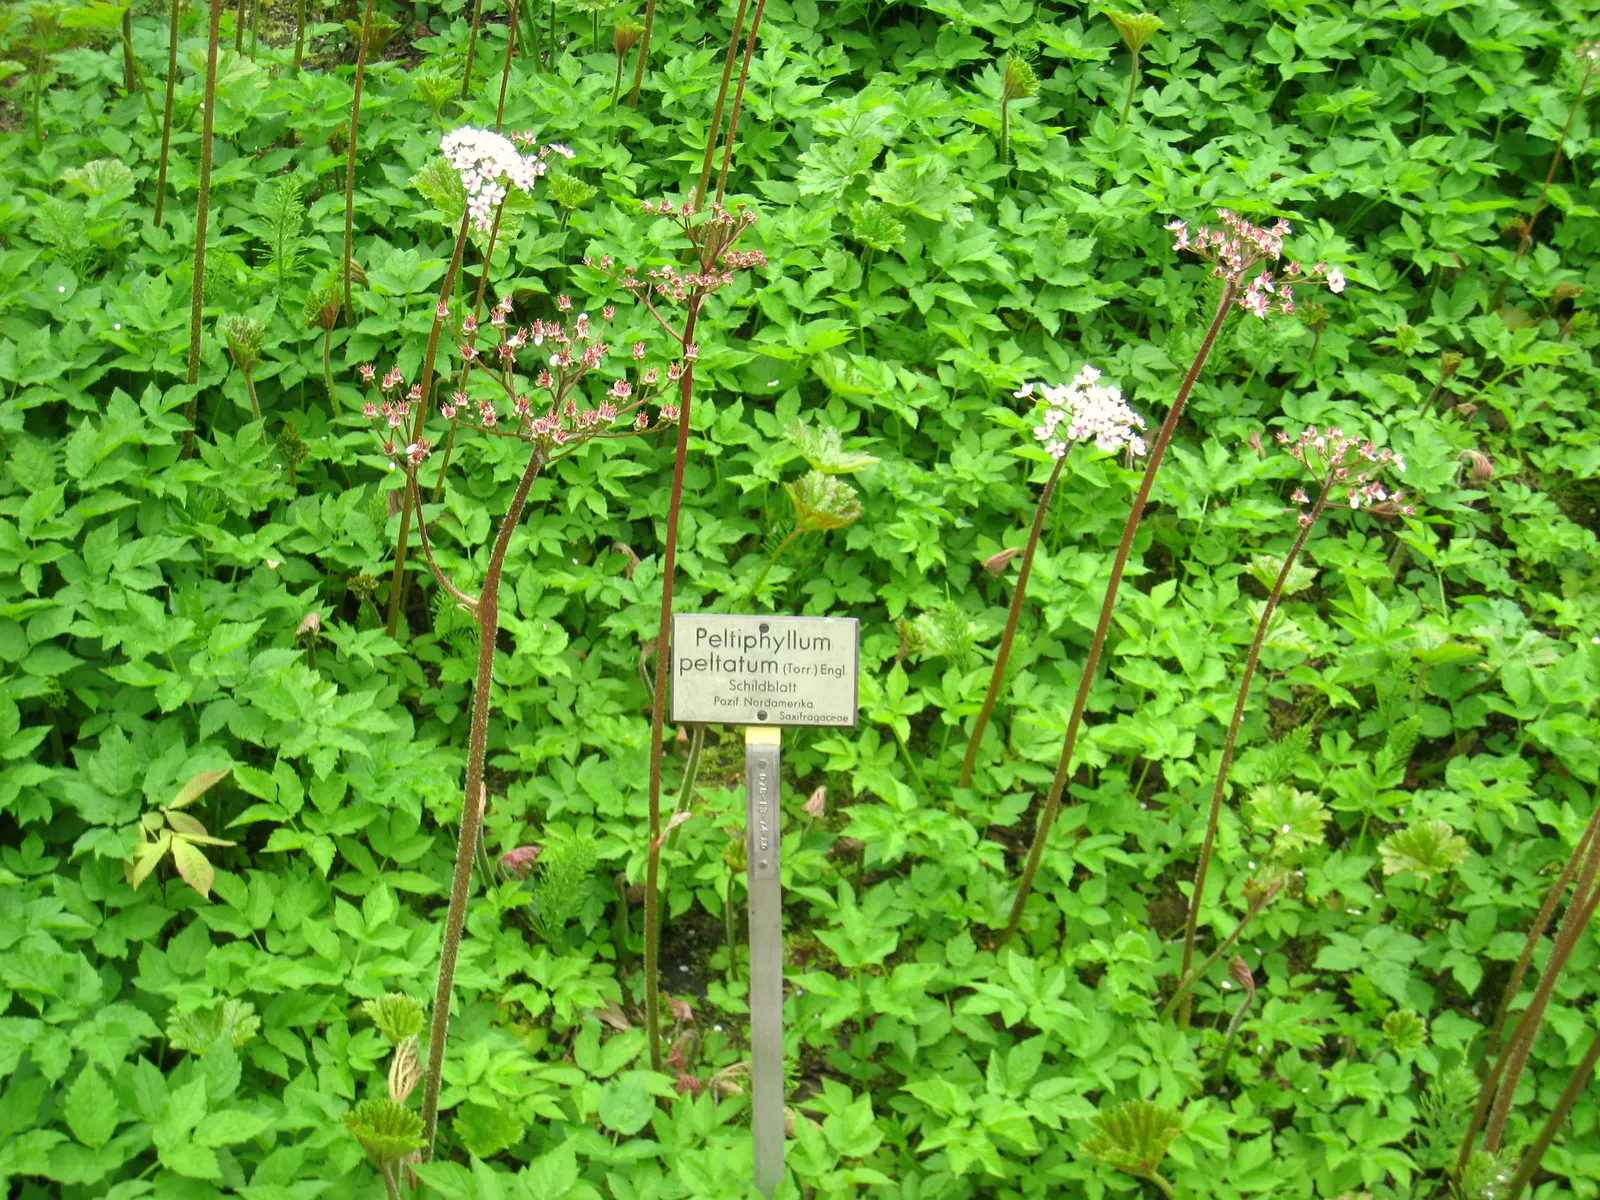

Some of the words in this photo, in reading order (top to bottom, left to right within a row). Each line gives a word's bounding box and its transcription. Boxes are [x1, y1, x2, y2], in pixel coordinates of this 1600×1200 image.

[696, 627, 831, 654] Peltiphyllum
[679, 652, 778, 676] peltatum
[783, 663, 818, 676] (Torr.)
[820, 664, 848, 679] Engl.
[729, 679, 797, 693] Schildblatt
[714, 696, 742, 706] Pazif.
[744, 697, 814, 709] Nordamerika
[779, 711, 849, 723] Saxifragaceae
